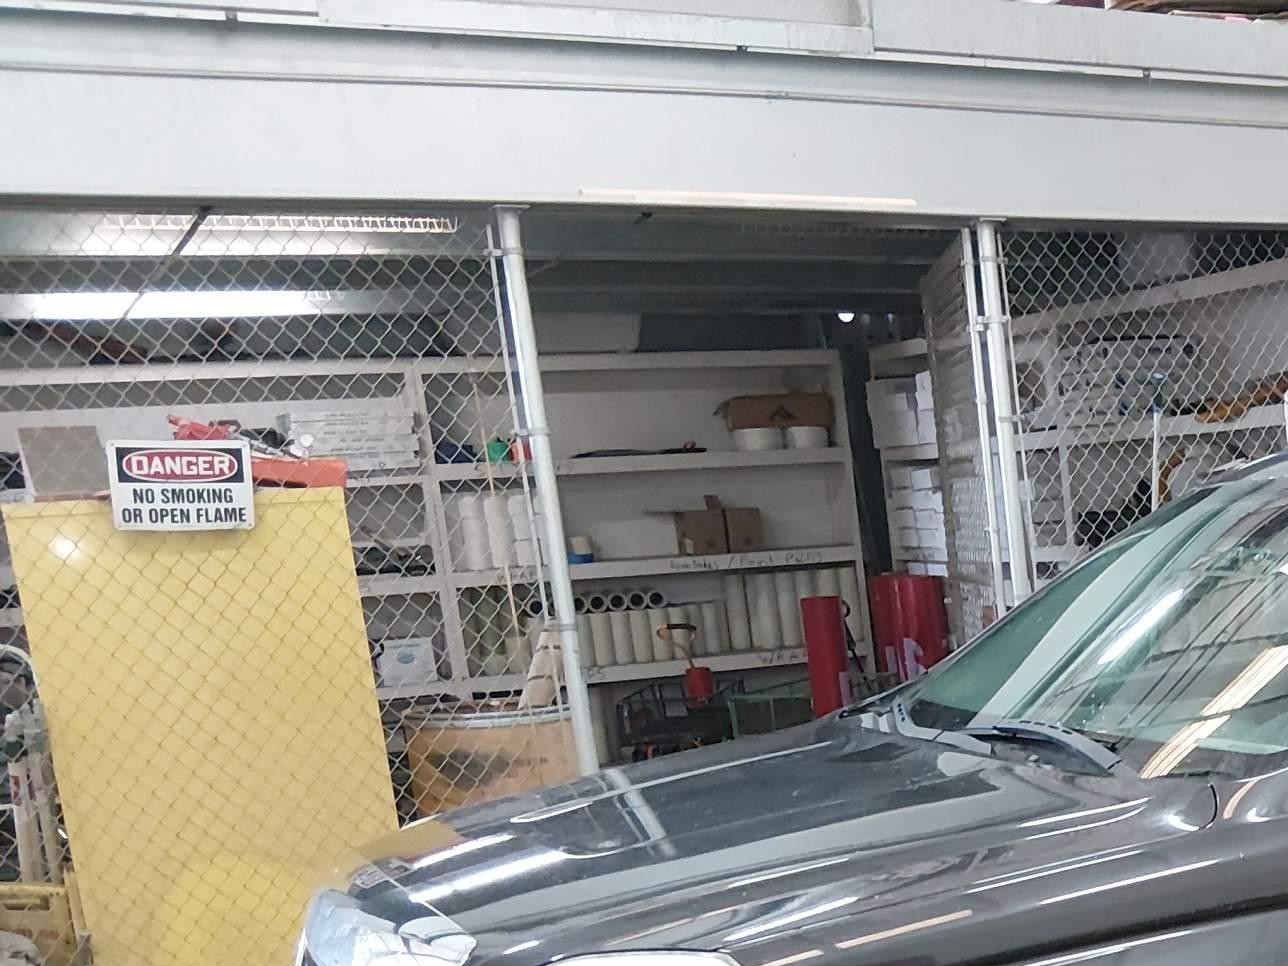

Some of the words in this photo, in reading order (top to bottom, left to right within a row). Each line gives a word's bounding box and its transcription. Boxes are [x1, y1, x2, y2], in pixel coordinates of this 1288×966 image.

[131, 455, 230, 475] DANGER
[132, 488, 155, 504] NO
[160, 488, 233, 504] SMOKING
[122, 508, 143, 523] OR
[148, 508, 190, 523] OPEN
[196, 507, 247, 523] FLAME
